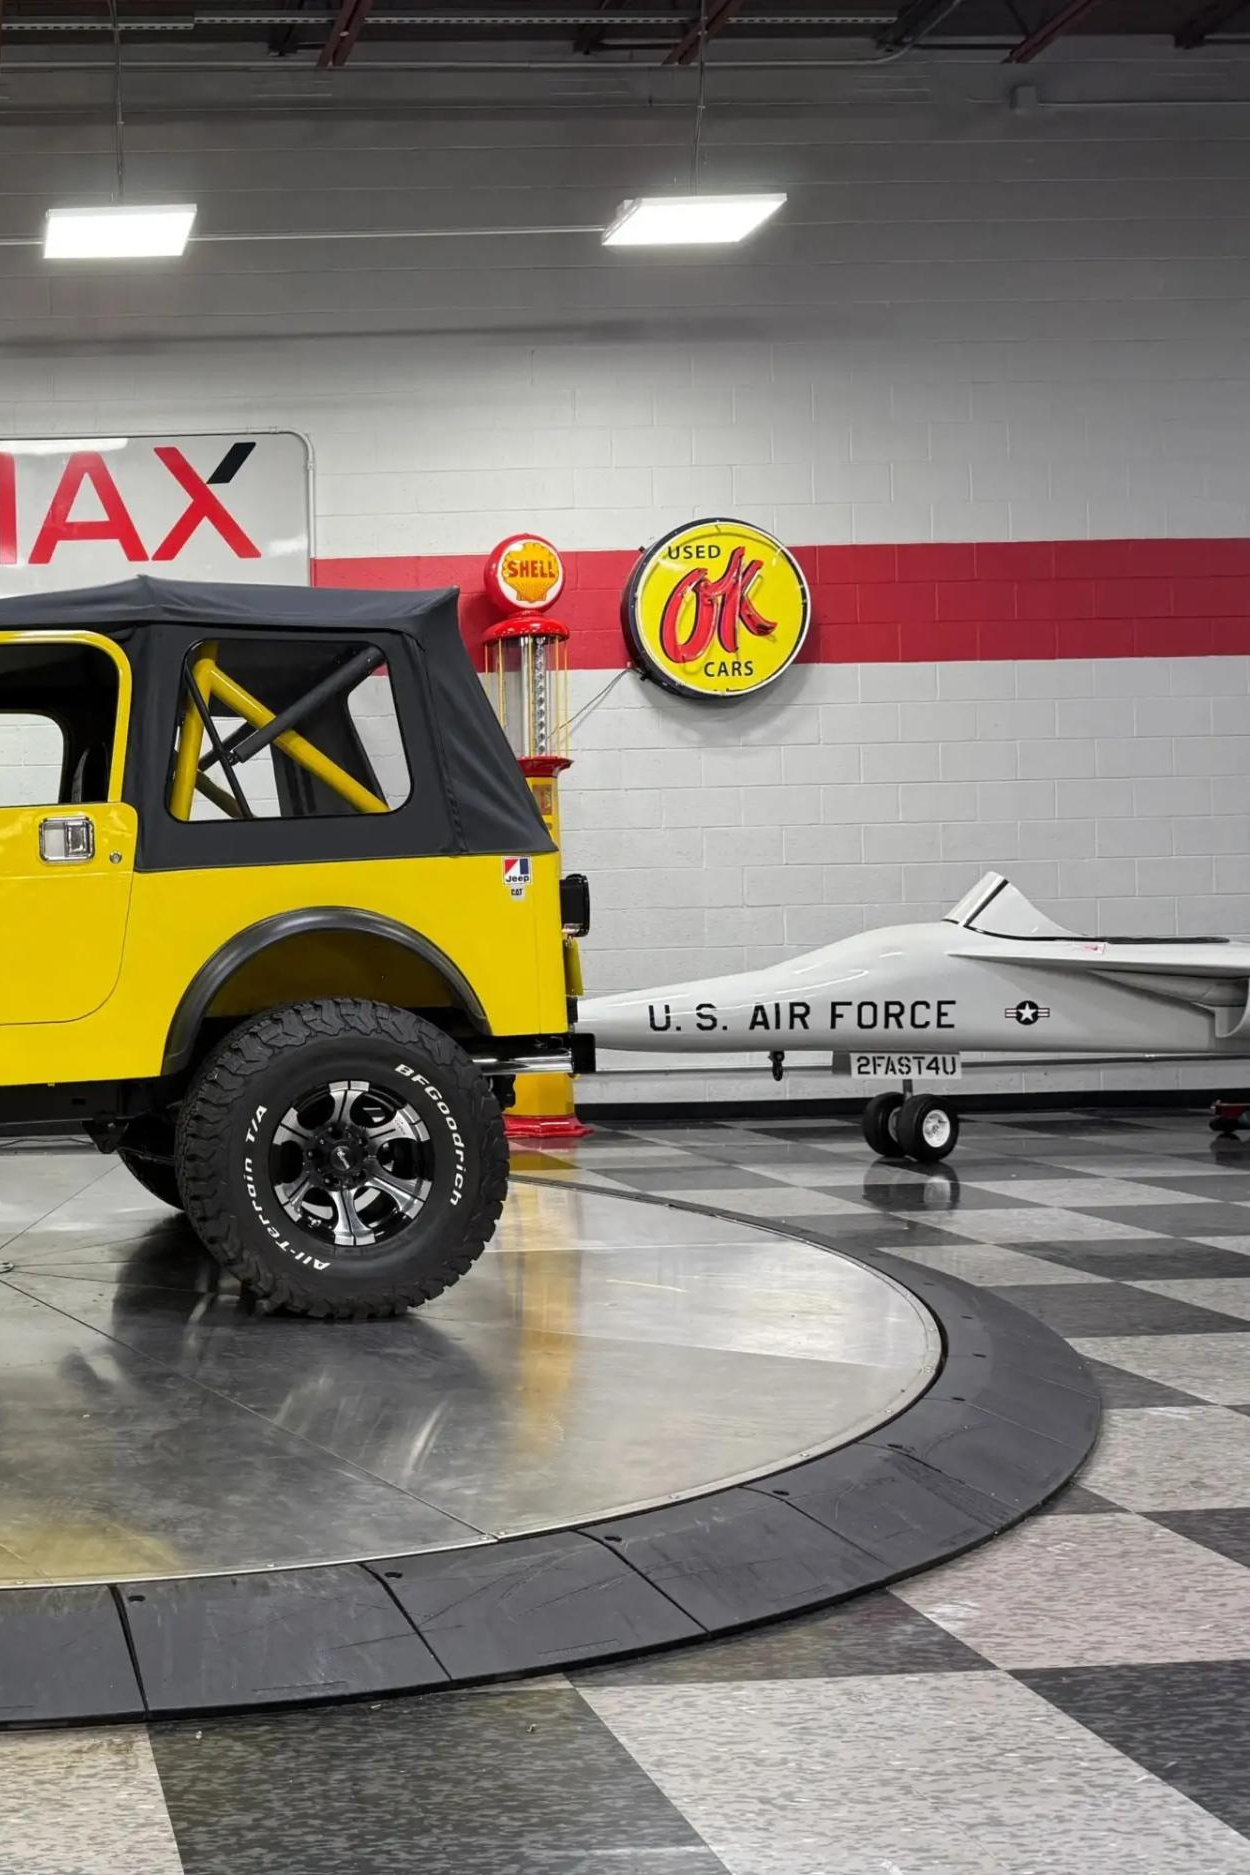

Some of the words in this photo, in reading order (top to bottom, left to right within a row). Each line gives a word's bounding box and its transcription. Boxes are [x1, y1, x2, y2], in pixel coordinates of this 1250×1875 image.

[667, 544, 721, 560] USED
[506, 559, 556, 578] SHELL
[660, 546, 778, 664] OK
[704, 660, 754, 677] CARS
[505, 875, 530, 883] Jeep
[748, 1002, 811, 1030] AIR
[830, 1000, 957, 1030] FORCE
[856, 1055, 957, 1075] 2FAST4U
[245, 1104, 269, 1144] T/A
[394, 1063, 465, 1206] BFGoodrich
[242, 1157, 332, 1271] All-Terrain
